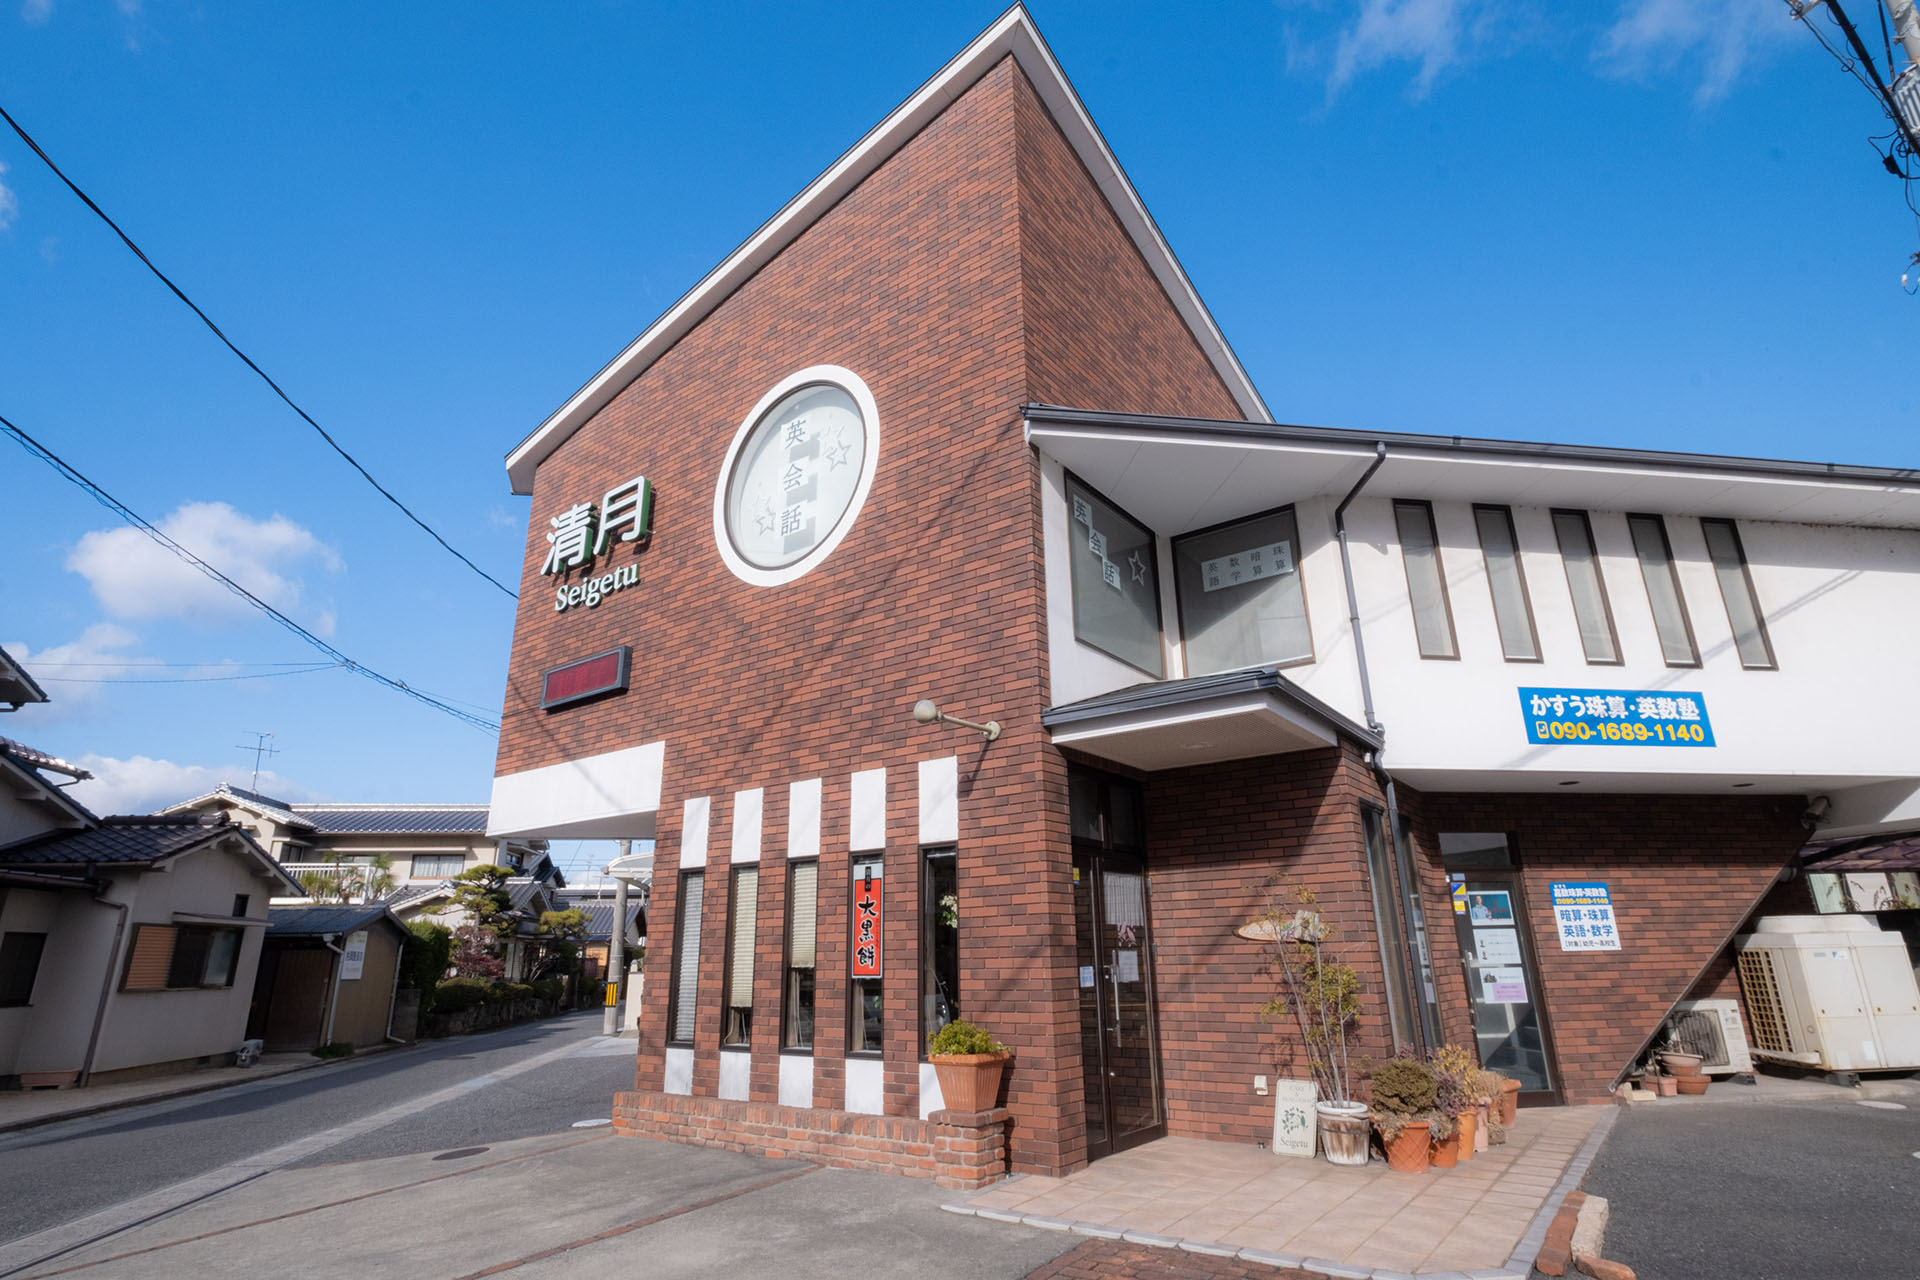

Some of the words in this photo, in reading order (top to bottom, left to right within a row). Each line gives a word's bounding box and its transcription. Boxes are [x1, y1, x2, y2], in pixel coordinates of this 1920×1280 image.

[781, 419, 807, 537] 英会話
[541, 476, 651, 576] 清月
[1075, 500, 1115, 584] 英会話
[554, 563, 640, 612] Seigetu
[1550, 721, 1705, 742] 090-1689-1140
[857, 895, 878, 968] 大黒餅
[1563, 925, 1613, 937] 英語・数学
